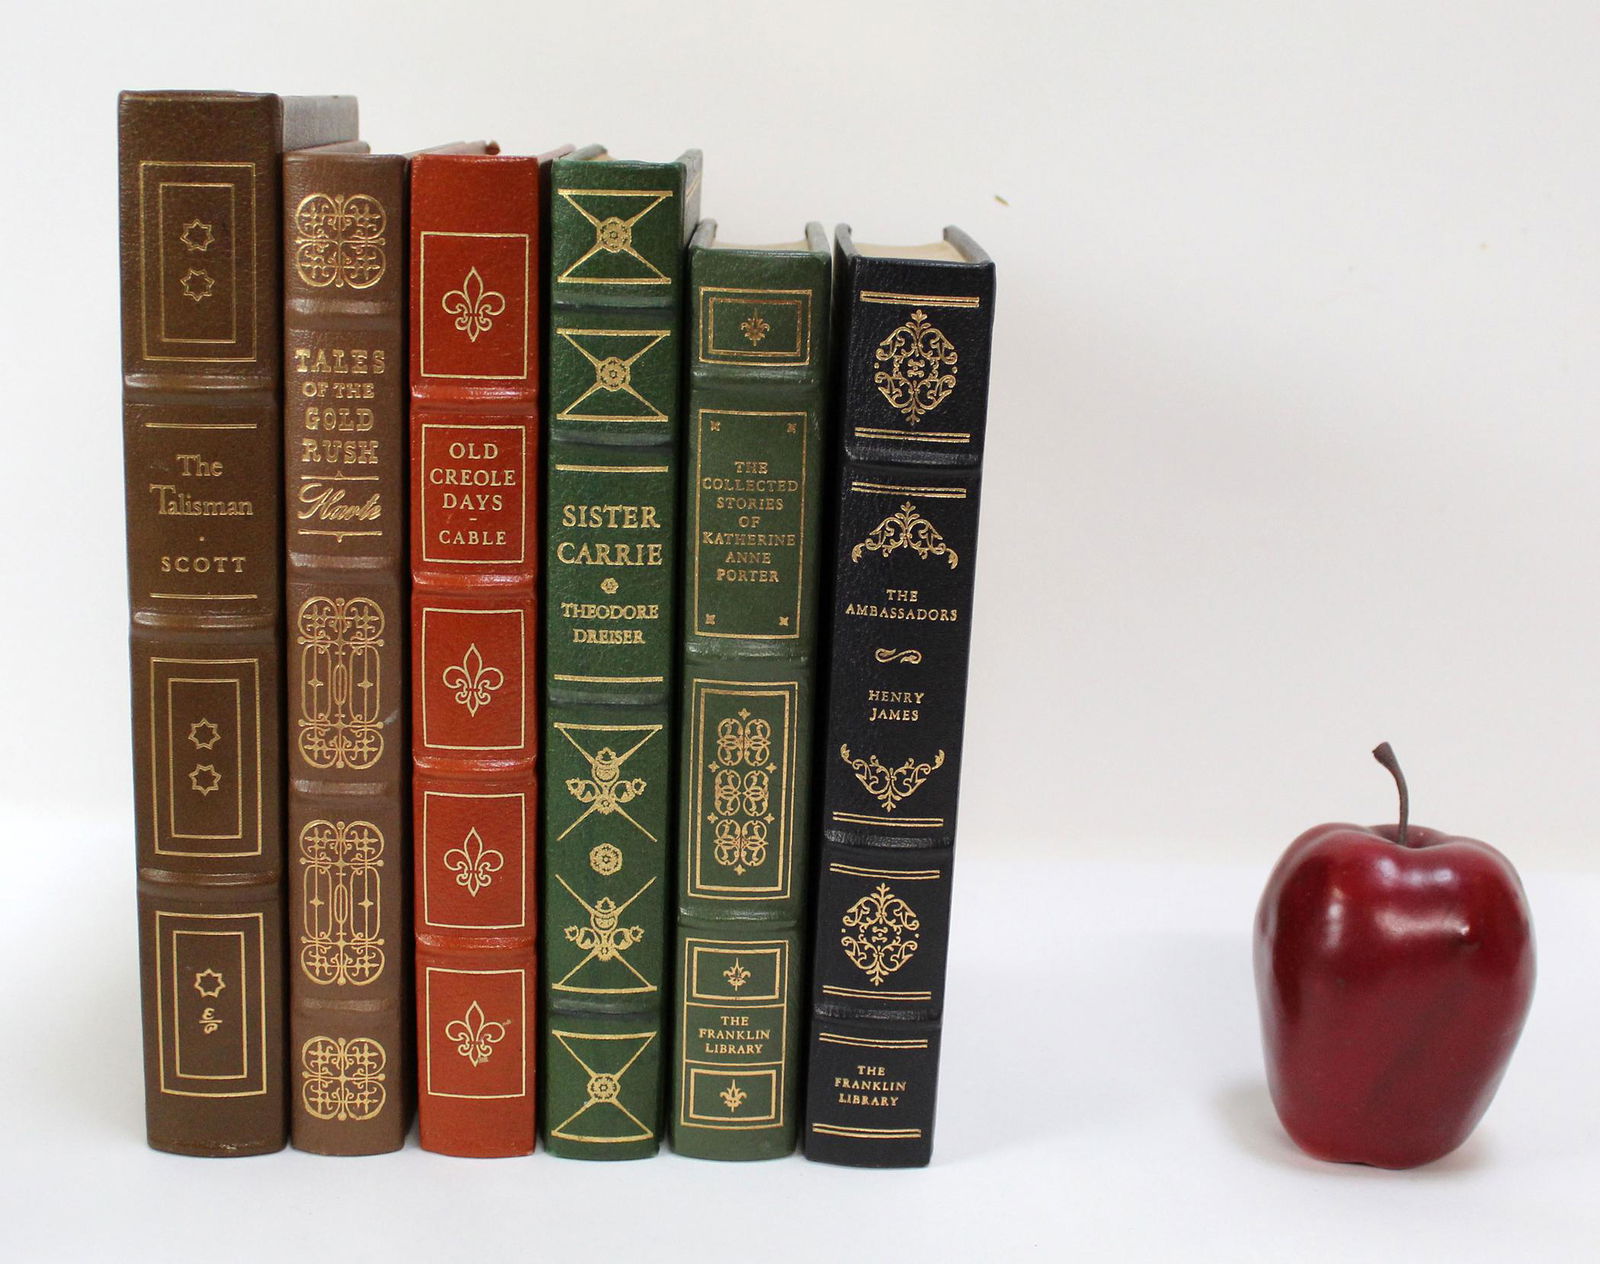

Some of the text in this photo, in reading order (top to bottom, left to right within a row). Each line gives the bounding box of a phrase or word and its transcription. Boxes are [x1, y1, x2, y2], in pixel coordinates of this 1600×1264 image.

[295, 349, 385, 374] TALES
[302, 382, 375, 399] OF THE
[305, 407, 375, 431] GOLD
[301, 438, 379, 464] RUSH
[449, 443, 498, 459] OLD
[176, 454, 223, 477] The
[734, 461, 768, 474] THE
[429, 468, 516, 486] CREOLE
[702, 477, 798, 492] COLLECTED
[149, 483, 253, 516] Talisman
[442, 493, 503, 511] DAYS
[716, 497, 784, 510] STORIES
[562, 504, 661, 529] SISTER
[738, 516, 760, 528] OF
[438, 530, 507, 545] CABLE
[702, 531, 796, 546] KATHERINE
[556, 541, 663, 566] CARRIE
[725, 551, 772, 565] ANNE
[160, 556, 247, 573] SCOTT
[716, 569, 779, 583] PORTER
[886, 588, 918, 602] THE
[561, 602, 659, 620] THEODORE
[845, 603, 958, 622] AMBASSADORS
[572, 628, 646, 645] DREISER
[868, 690, 925, 704] HENRY
[869, 708, 920, 722] JAMES
[720, 1016, 749, 1027] THE
[698, 1028, 771, 1040] FRANKLIN
[705, 1043, 764, 1055] LIBRARY
[857, 1065, 886, 1077] THE
[834, 1077, 907, 1092] FRANKLIN
[838, 1092, 899, 1108] LIBRARY
